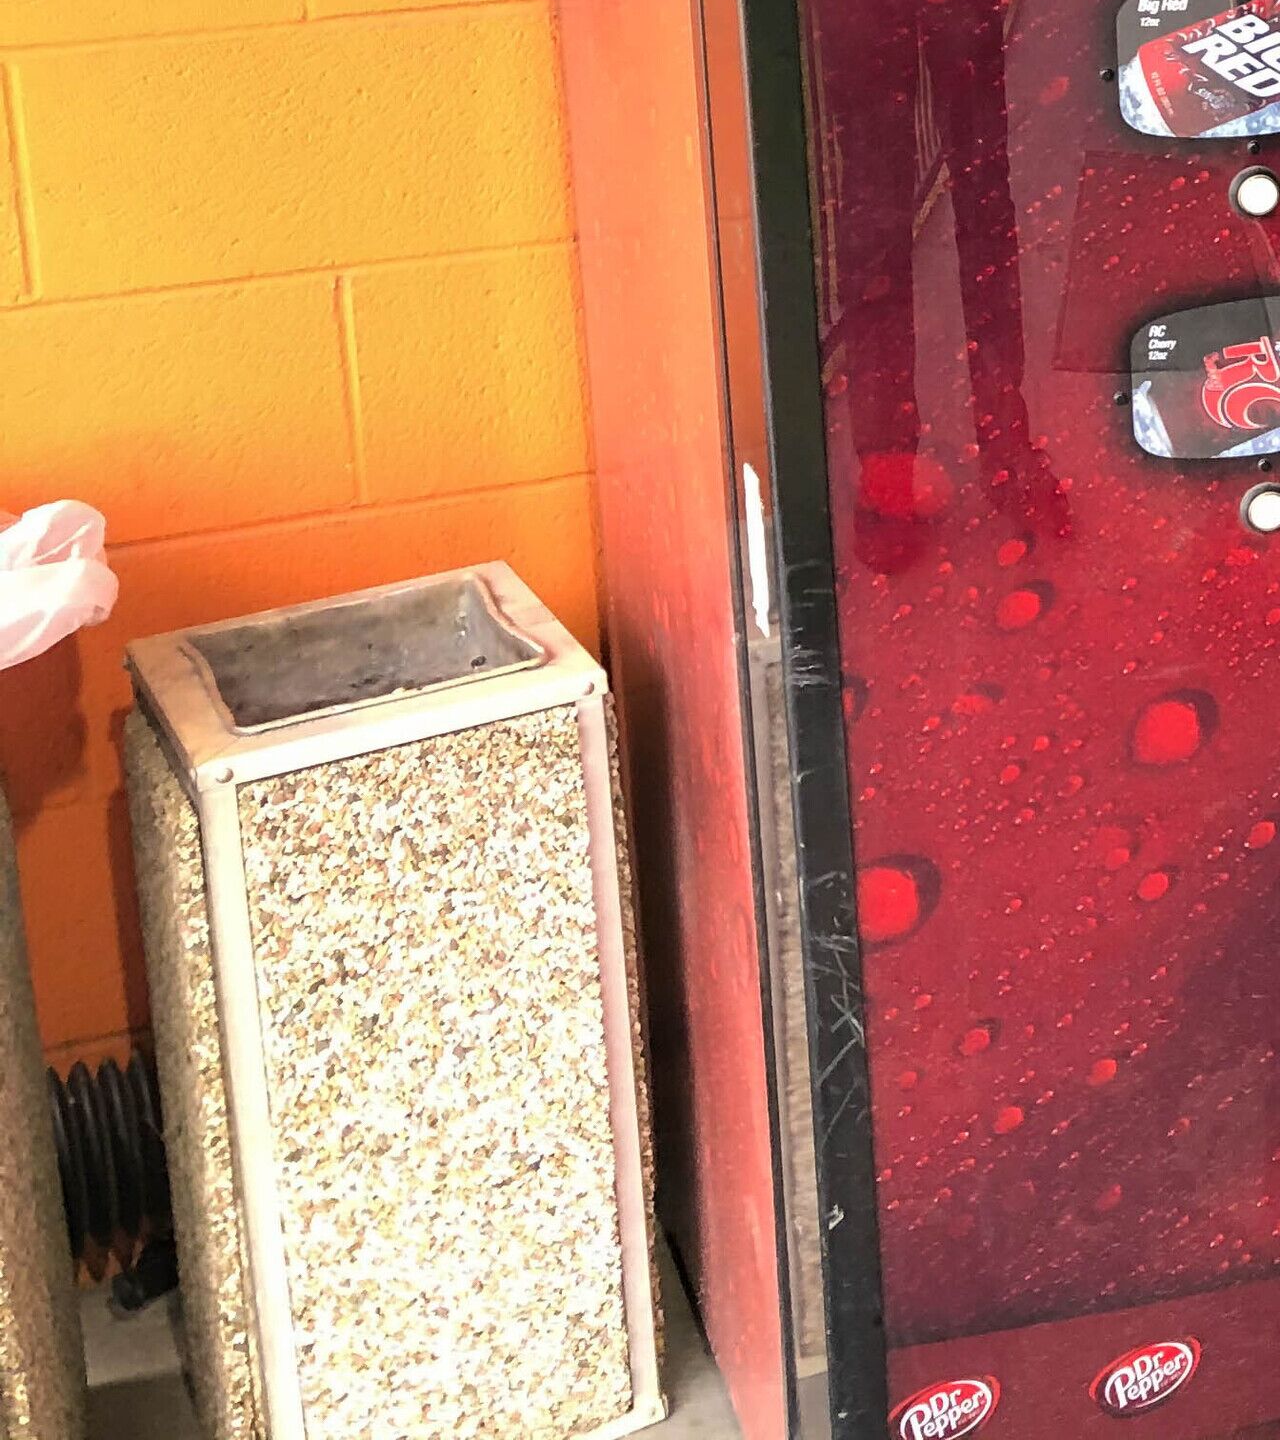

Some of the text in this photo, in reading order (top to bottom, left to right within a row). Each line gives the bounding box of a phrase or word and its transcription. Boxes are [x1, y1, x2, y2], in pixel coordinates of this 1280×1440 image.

[1139, 17, 1161, 28] 12oz
[1148, 324, 1167, 338] RC
[1147, 338, 1177, 352] Cherry
[1147, 350, 1168, 361] 12oz
[1131, 1349, 1164, 1375] Dr
[1106, 1353, 1187, 1409] Pepper
[928, 1387, 962, 1414] Dr
[901, 1392, 985, 1440] Pepper
